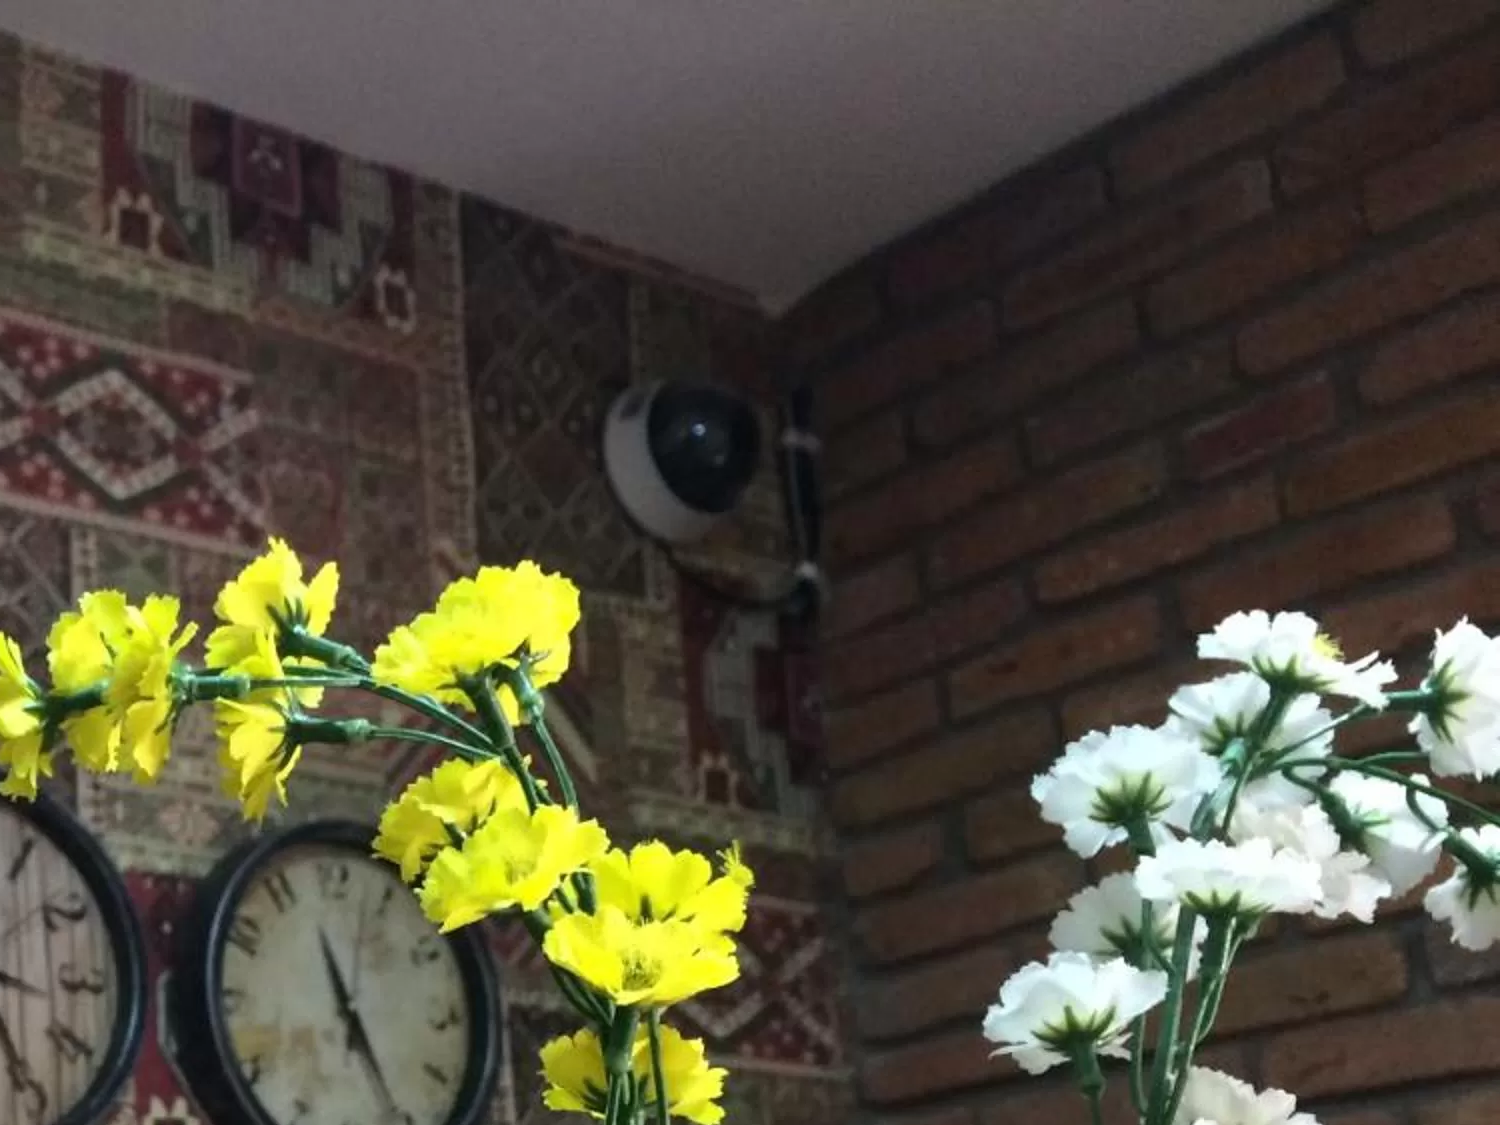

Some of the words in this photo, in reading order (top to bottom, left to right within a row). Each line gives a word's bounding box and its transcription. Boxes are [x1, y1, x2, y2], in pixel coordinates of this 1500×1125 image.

[10, 838, 36, 881] 1
[42, 893, 88, 932] 2
[58, 962, 106, 996] 3
[46, 1021, 94, 1064] 4
[12, 1058, 48, 1121] 5
